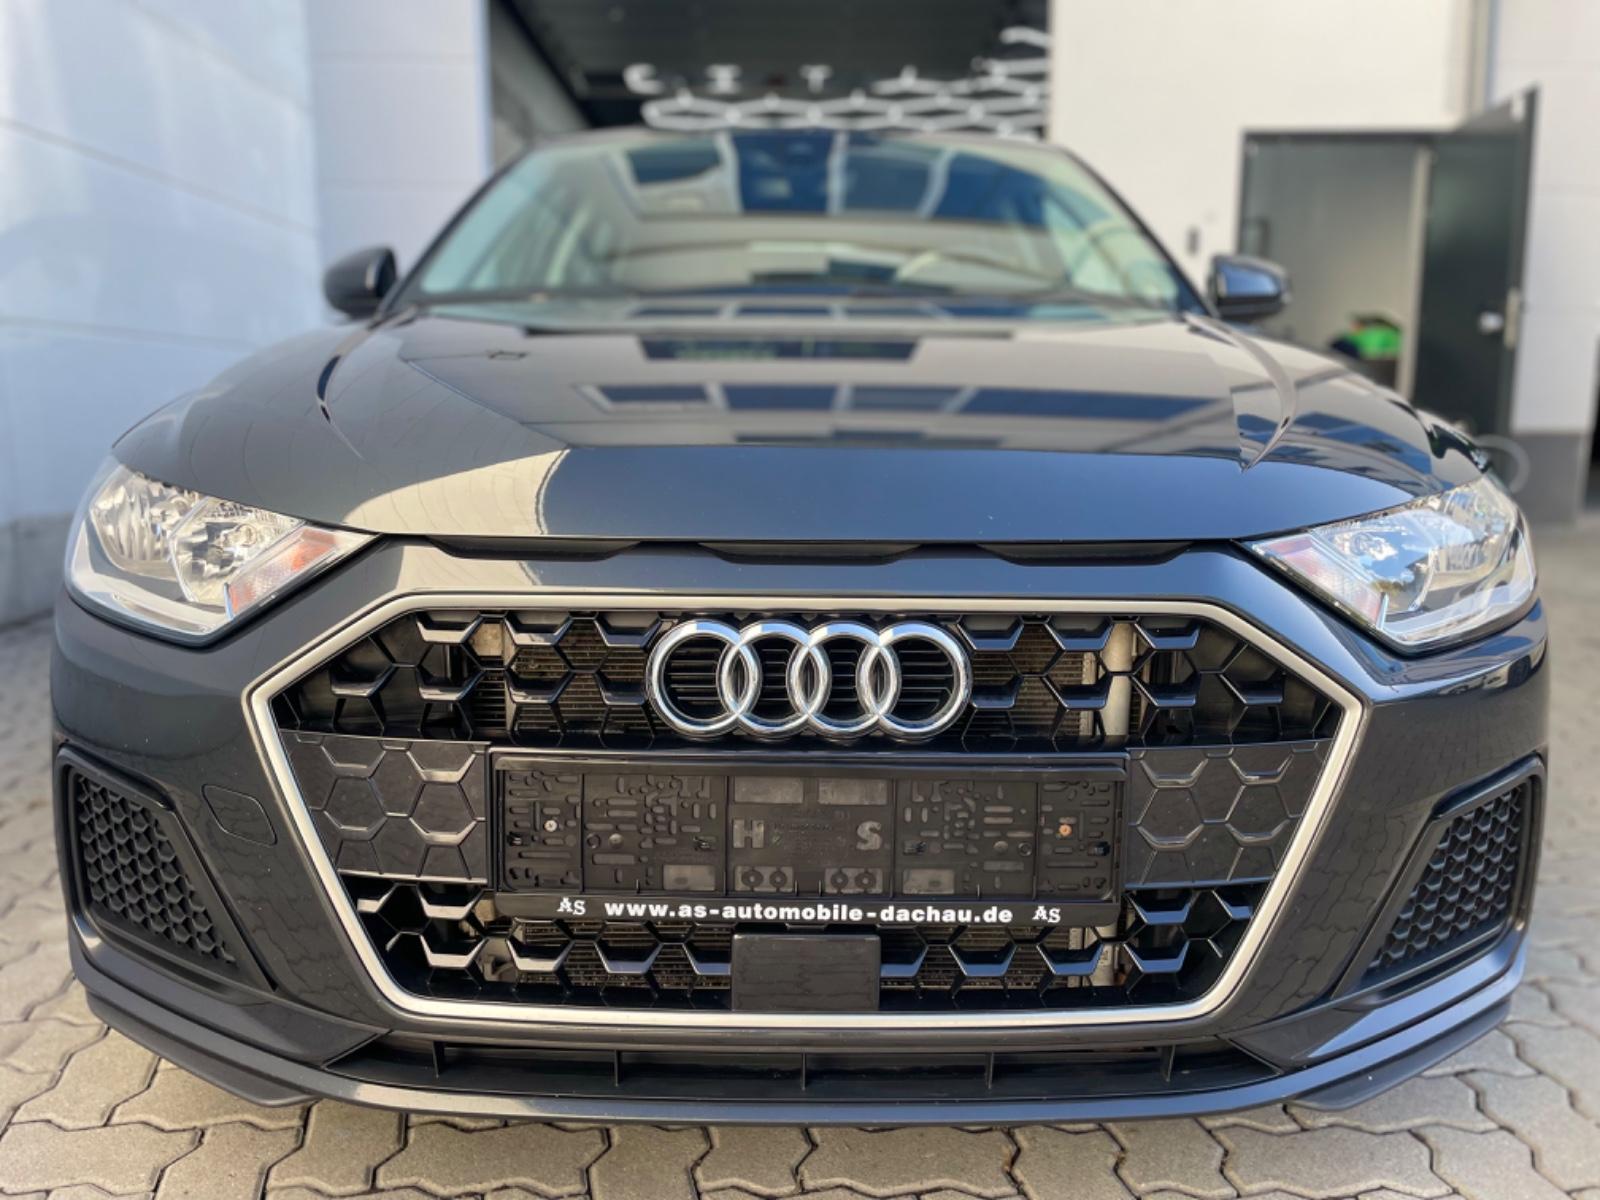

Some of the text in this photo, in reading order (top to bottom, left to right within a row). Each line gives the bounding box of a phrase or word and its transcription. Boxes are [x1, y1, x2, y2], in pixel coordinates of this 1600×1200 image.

[556, 896, 1062, 924] AS www.as-automobile-dachau.de AS
